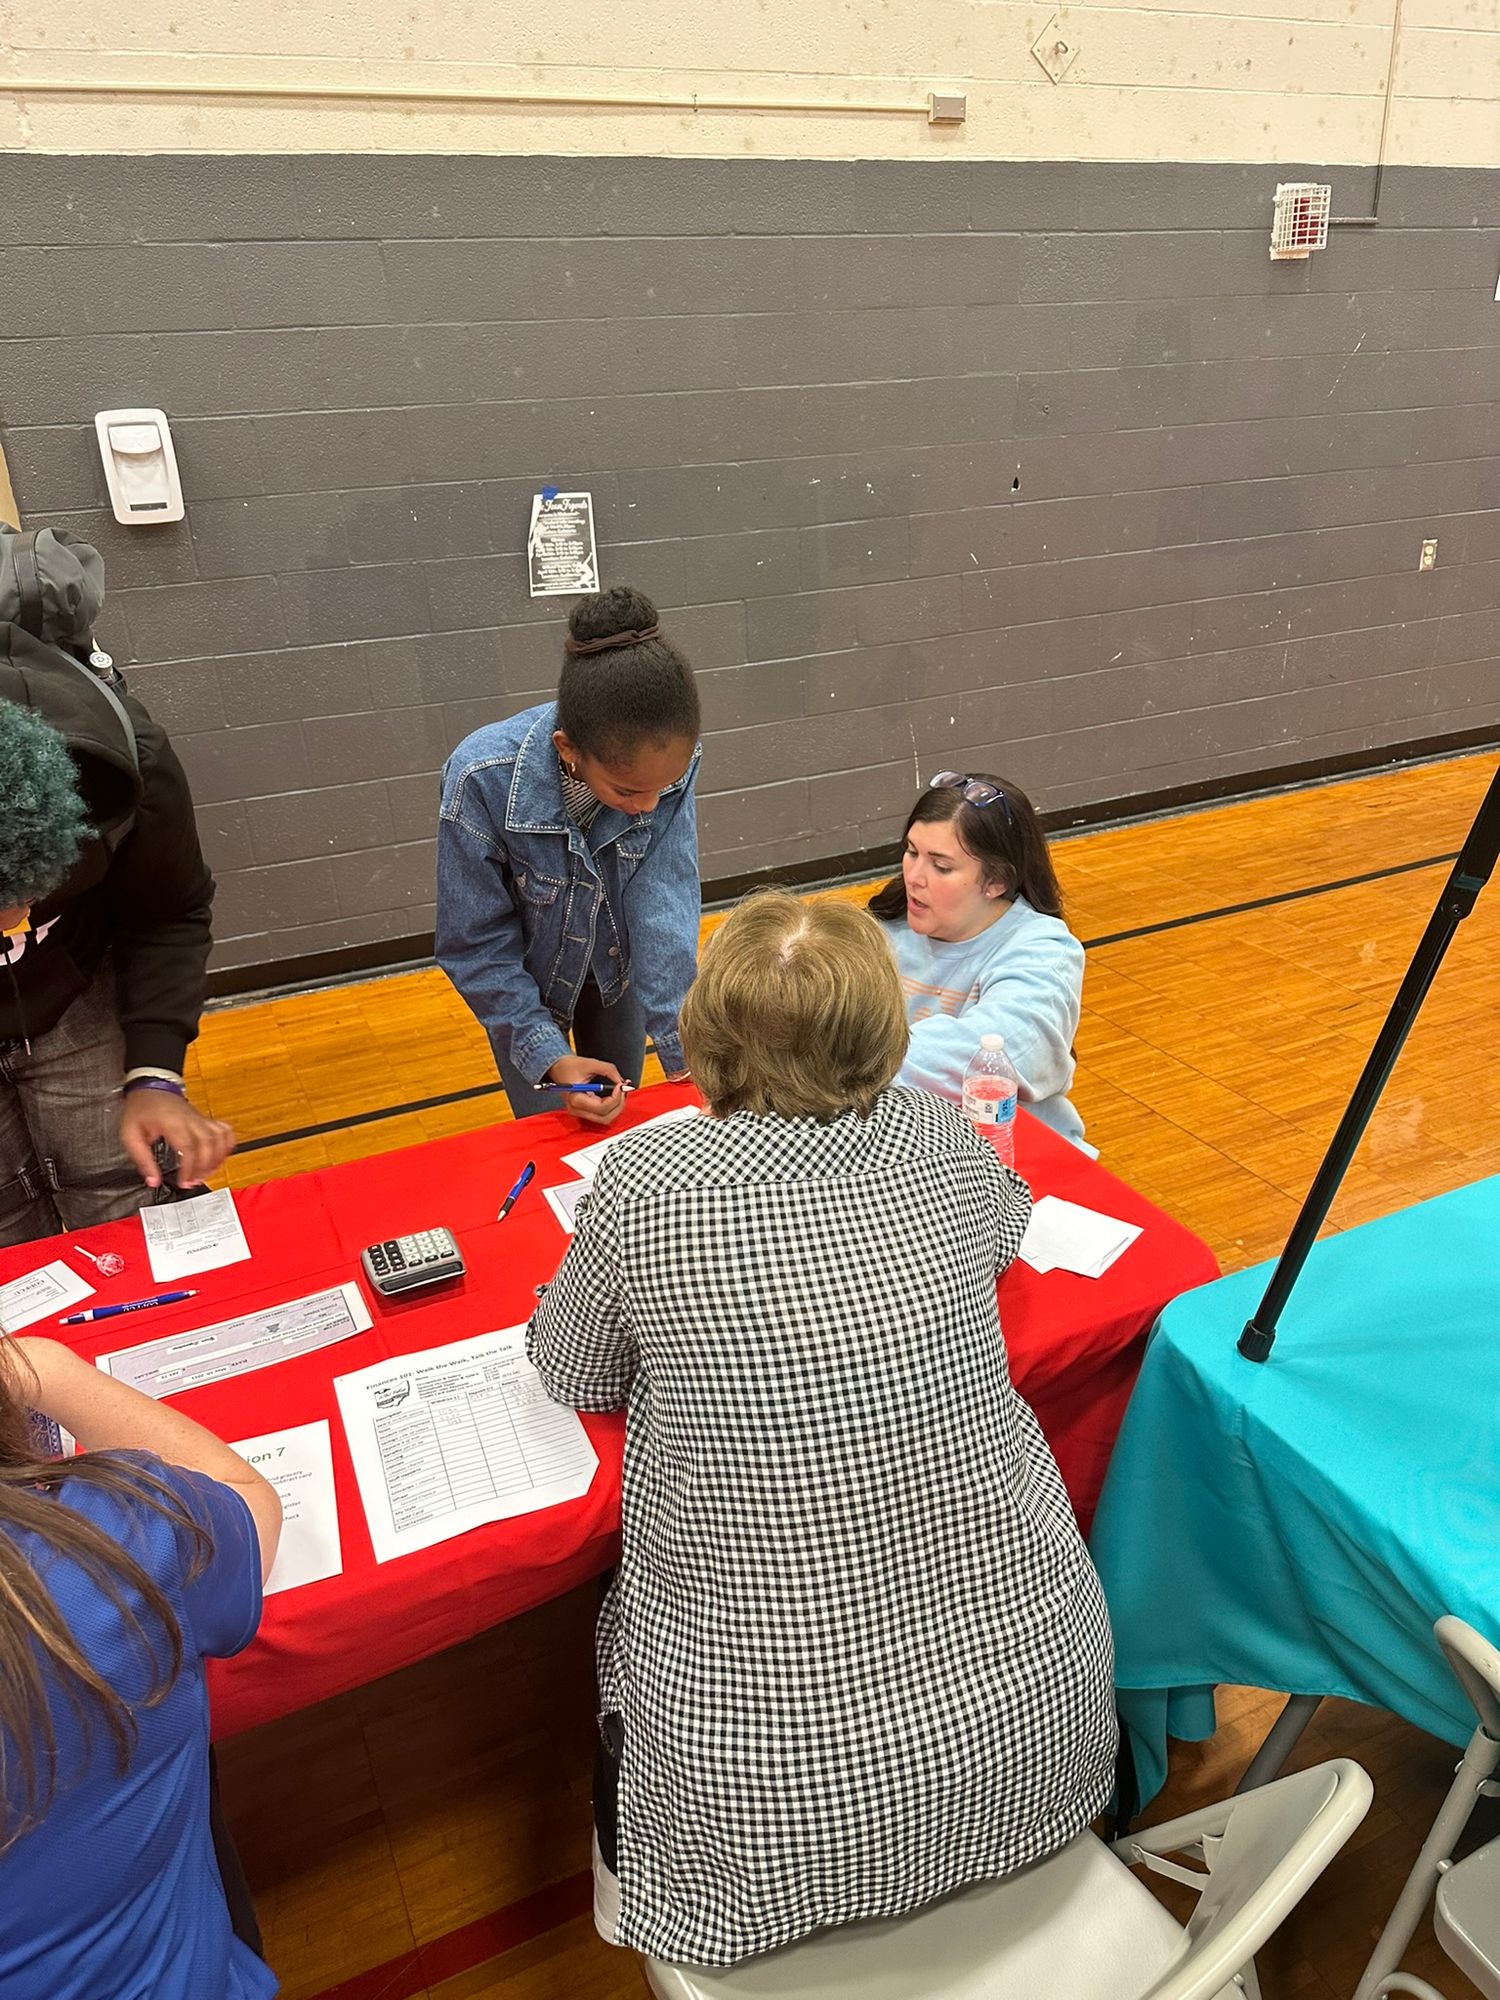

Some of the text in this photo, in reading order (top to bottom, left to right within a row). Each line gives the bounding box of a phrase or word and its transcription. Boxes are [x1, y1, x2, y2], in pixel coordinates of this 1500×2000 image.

[366, 1376, 397, 1390] Finances
[416, 1366, 434, 1374] Walk
[449, 1357, 469, 1367] Walk,
[246, 1447, 286, 1465] ion 7
